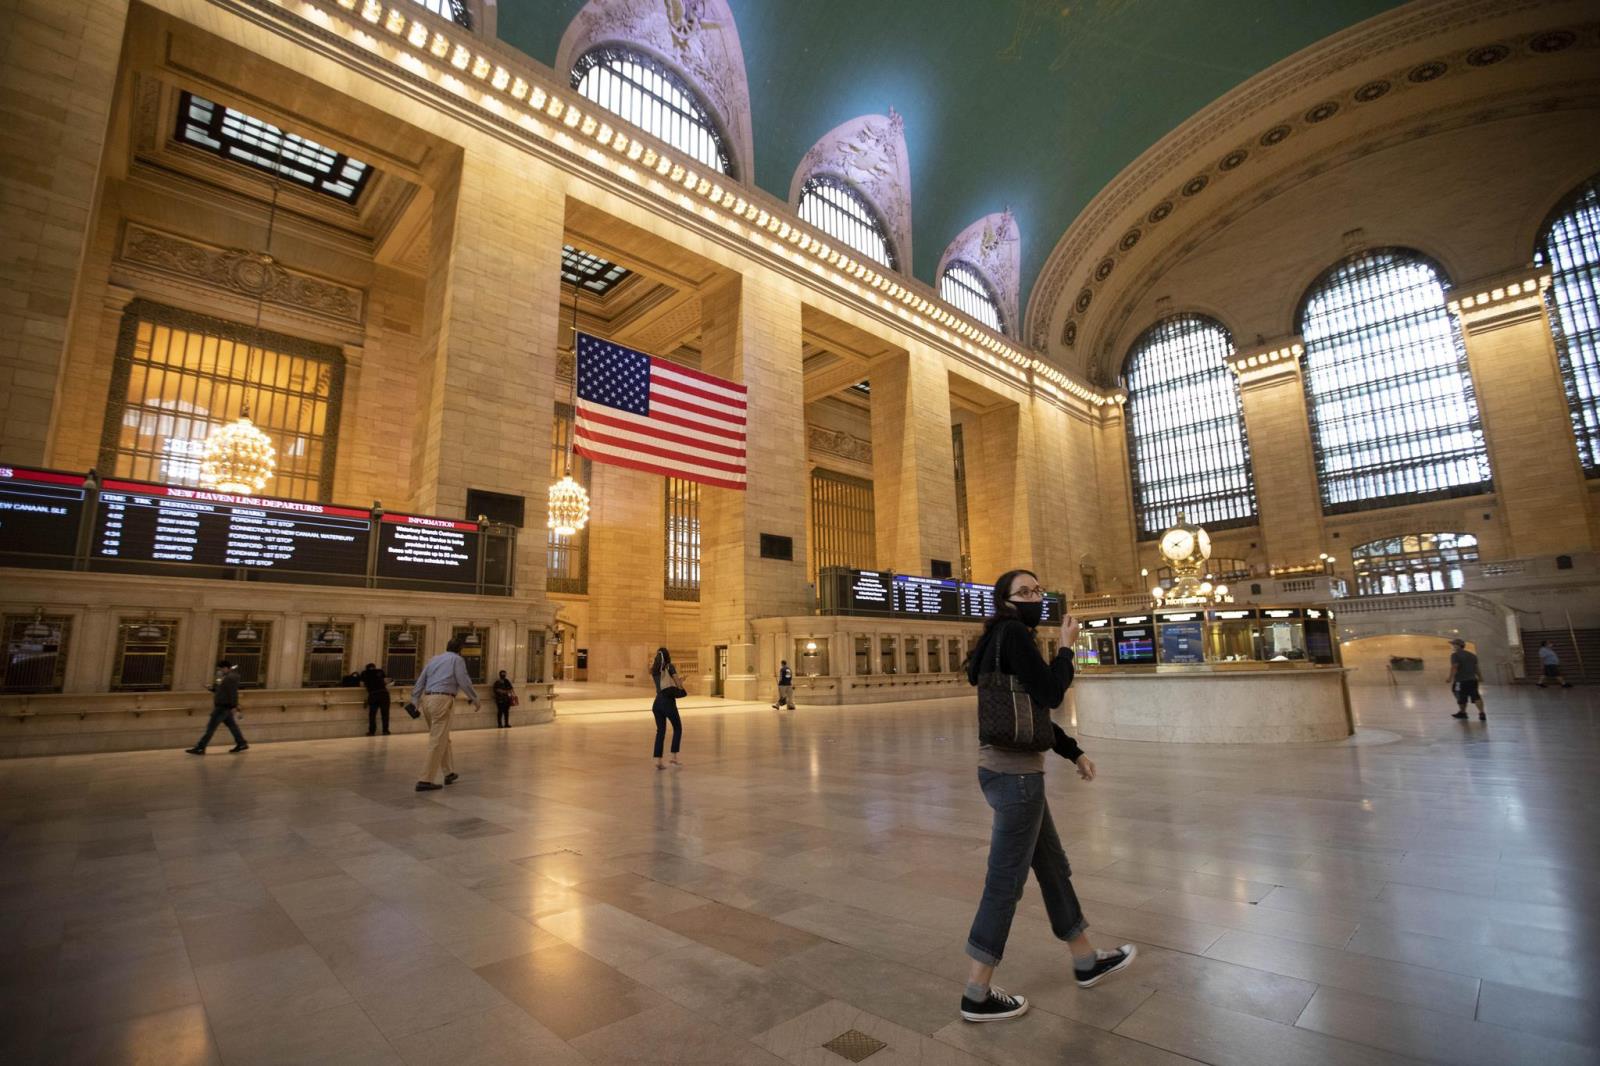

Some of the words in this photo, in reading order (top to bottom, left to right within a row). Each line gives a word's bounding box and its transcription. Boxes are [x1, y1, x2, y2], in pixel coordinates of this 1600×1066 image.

[168, 488, 192, 498] NEW
[196, 491, 234, 502] HAVEN
[236, 497, 261, 506] LINE
[262, 499, 324, 512] DEPARTURES
[159, 500, 214, 512] DESTINATION
[232, 508, 266, 517] REMARKS
[230, 516, 262, 524] FORDHAM
[408, 516, 454, 528] INFORMATION
[156, 526, 196, 535] STAMFORD
[228, 532, 261, 540] FORDHAM
[230, 524, 271, 534] CONNECTION
[320, 533, 355, 542] WATERBURY
[396, 526, 421, 534] Waterbury
[394, 533, 419, 541] Substitute
[153, 544, 194, 552] STAMFORD
[227, 541, 263, 549] STAMFORD
[1165, 596, 1207, 606] Information
